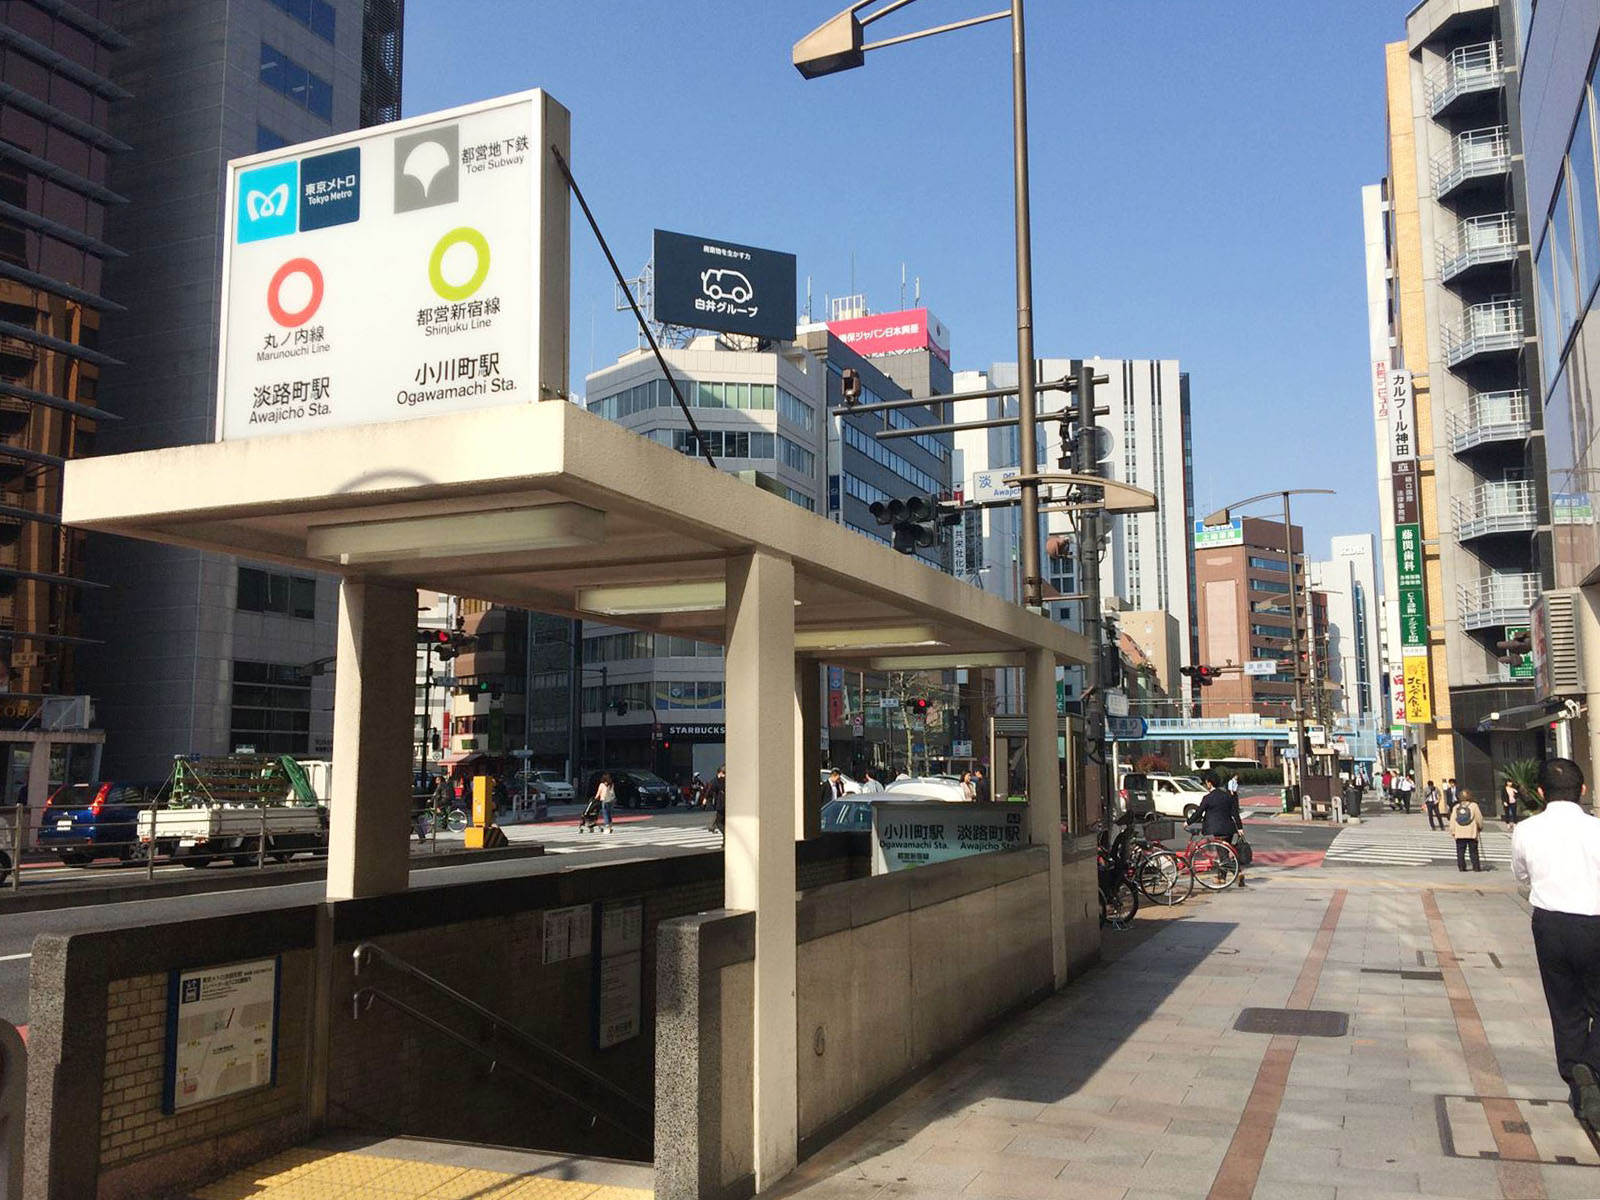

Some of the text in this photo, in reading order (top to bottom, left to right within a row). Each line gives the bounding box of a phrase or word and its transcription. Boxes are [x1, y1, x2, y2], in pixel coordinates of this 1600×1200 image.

[461, 135, 530, 165] 都営地下鉄
[466, 155, 525, 174] Toei Subway
[305, 175, 355, 196] 東京メトロ
[308, 189, 353, 206] Tokyo Metro
[416, 297, 501, 327] 都営新宿線
[695, 298, 758, 317] 白井グループ
[425, 317, 492, 337] Shinjuku Line
[263, 325, 325, 351] 丸ノ内線
[256, 342, 330, 362] Marunouchi Line
[414, 353, 500, 386] 小川町駅
[252, 377, 331, 409] 淡路町駅
[396, 377, 518, 407] Ogawamachi Sta.
[308, 402, 332, 417] Sta.
[1393, 374, 1409, 456] カルフール神田
[669, 726, 726, 734] STARBUCKS
[884, 824, 1021, 841] 小川町駅 淡路町駅
[880, 841, 932, 850] Ogawamachi
[934, 842, 949, 850] Sta.
